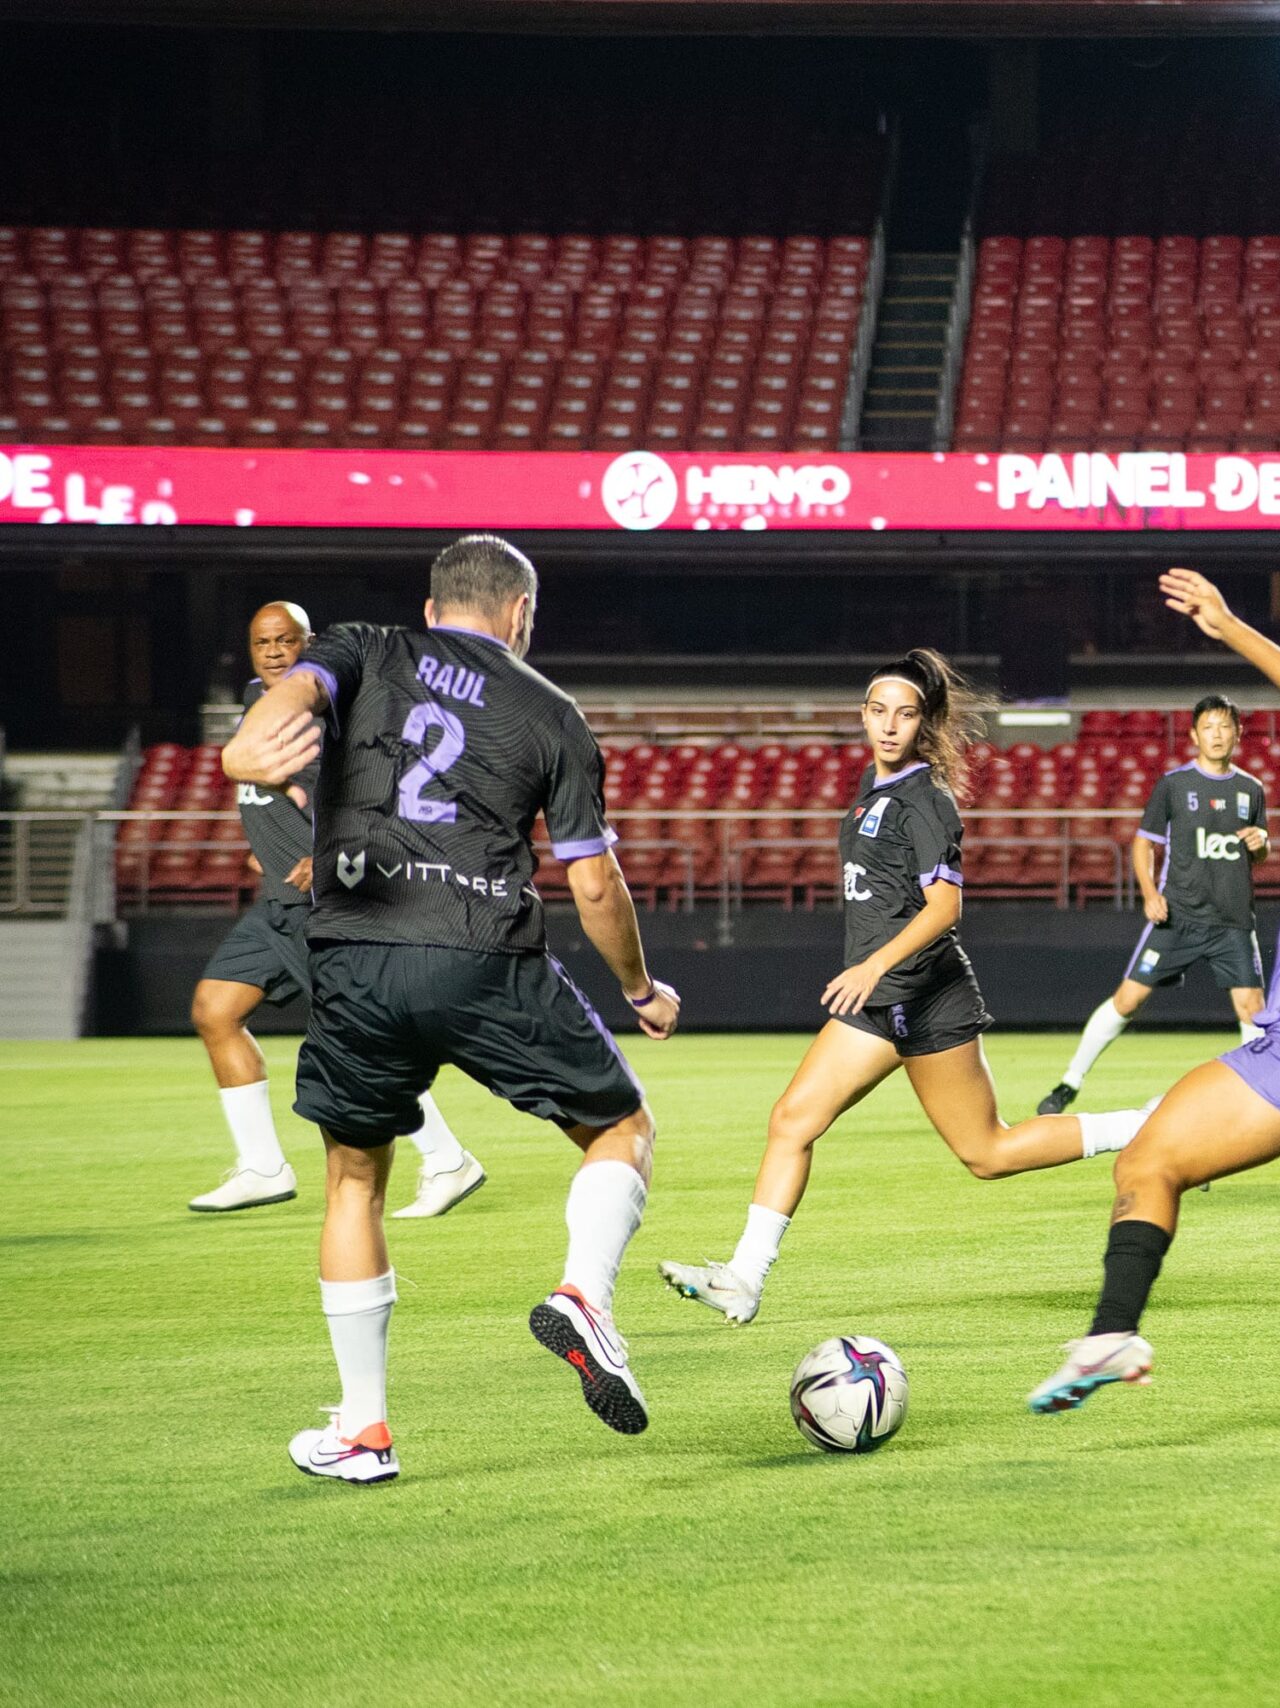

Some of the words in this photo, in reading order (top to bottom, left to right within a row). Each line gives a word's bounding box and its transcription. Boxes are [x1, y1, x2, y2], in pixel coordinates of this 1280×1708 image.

[0, 452, 54, 508] E
[997, 452, 1206, 509] PAINEL
[416, 655, 485, 707] RAUL
[398, 701, 465, 823] 2
[1188, 791, 1199, 811] 5
